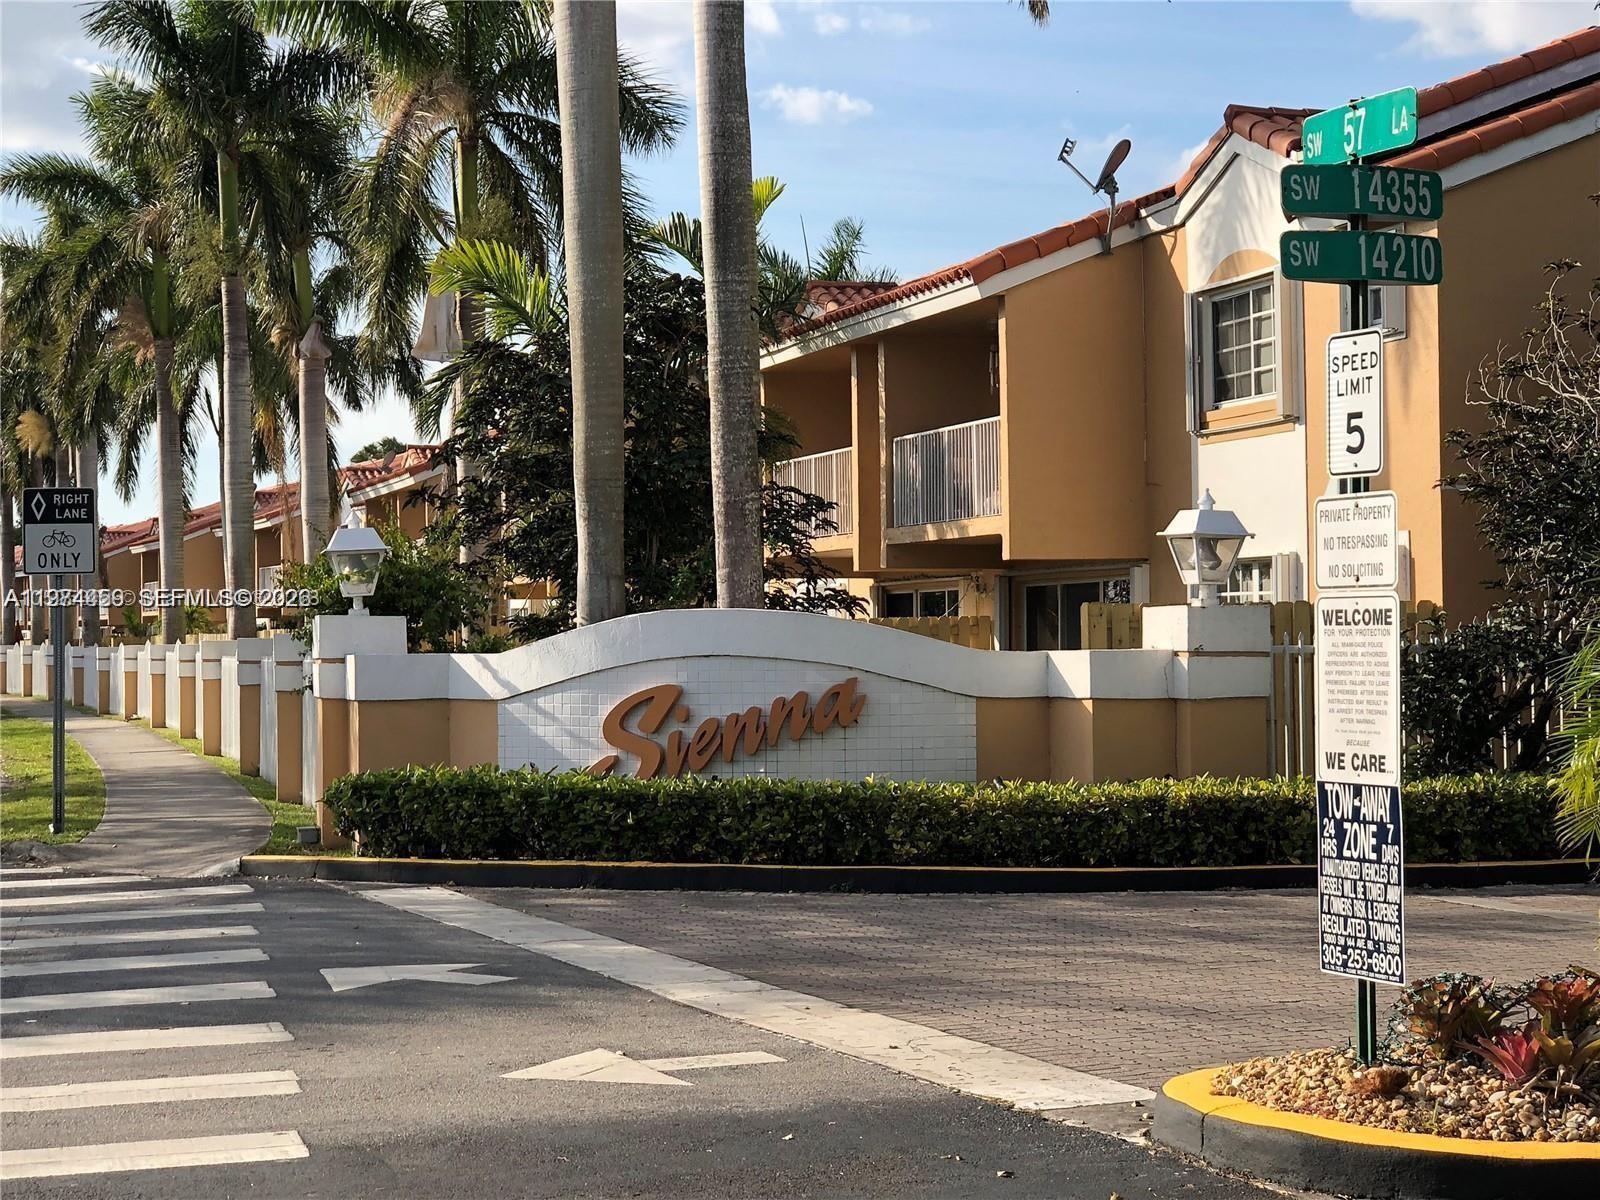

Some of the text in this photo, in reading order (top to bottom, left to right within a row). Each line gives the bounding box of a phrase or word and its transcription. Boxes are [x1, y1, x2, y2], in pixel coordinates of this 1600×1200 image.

[1306, 107, 1408, 160] SW 57 LA
[1291, 168, 1431, 216] SW 14355
[1289, 235, 1435, 281] SW 14210
[1332, 352, 1378, 373] SPEED
[1336, 376, 1373, 397] LIMIT
[1346, 412, 1364, 454] 5
[53, 494, 89, 504] RIGHT
[55, 508, 88, 519] LANE
[1320, 505, 1391, 523] PRIVATE PROPERTY
[1323, 533, 1388, 551] NO TRESPASSING
[37, 552, 81, 569] ONLY
[1328, 562, 1383, 578] NO SOLICITING
[1322, 608, 1393, 626] WELCOME
[1324, 629, 1391, 637] FOR YOUR PROTECTION
[586, 677, 867, 780] Sienna
[1346, 739, 1370, 747] BECAUSE
[1325, 752, 1346, 770] WE
[1324, 783, 1391, 823] TOW-AWAY
[1323, 817, 1394, 860] 24 ZONE 7
[1321, 837, 1399, 865] HRS DAYS
[1322, 857, 1398, 884] UNAUTHORIZED VEHICLES OR
[1320, 876, 1400, 903] VESSELS WILL BE TOWED AWAY
[1323, 895, 1329, 912] AT
[1353, 899, 1367, 918] RISK
[1368, 901, 1372, 919] &
[1373, 902, 1398, 923] EXPENSE
[1321, 914, 1400, 944] REGULATED TOWING
[1337, 936, 1345, 945] SW
[1322, 944, 1401, 976] 305-253-6900
